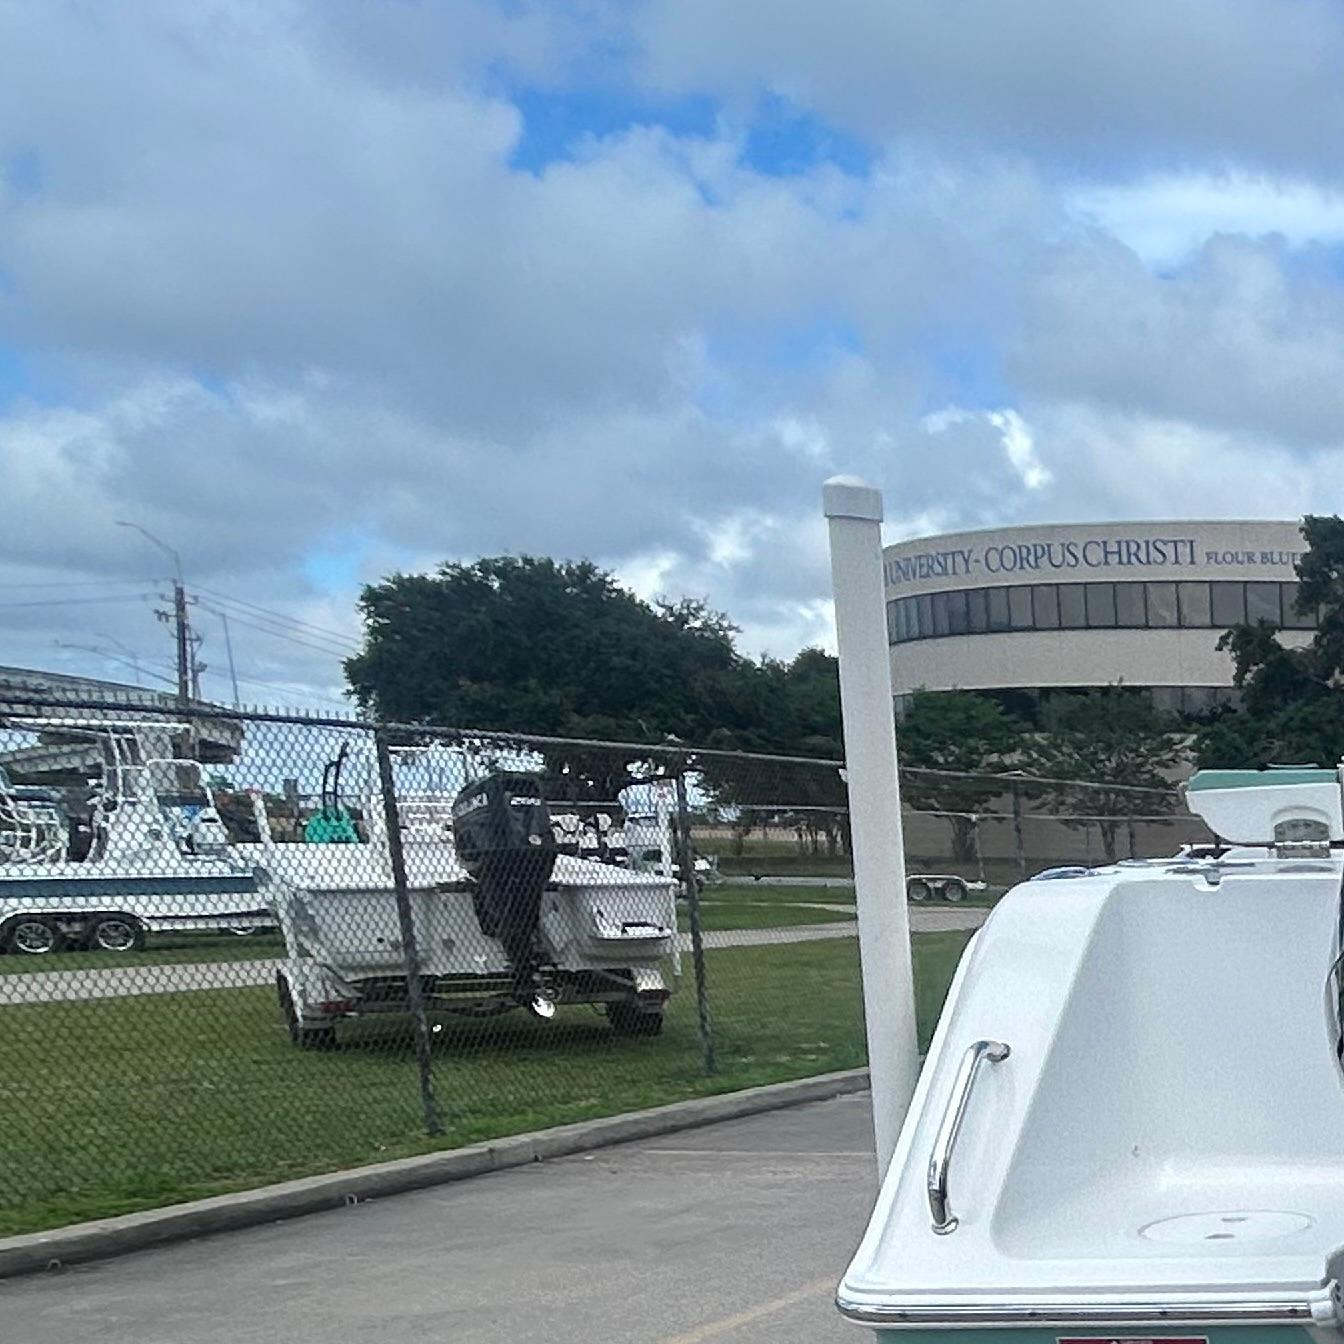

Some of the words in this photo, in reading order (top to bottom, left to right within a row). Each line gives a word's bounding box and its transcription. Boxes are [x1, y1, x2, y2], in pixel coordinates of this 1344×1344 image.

[985, 541, 1079, 574] CORPUS
[1082, 539, 1197, 568] CHRISTI
[1205, 551, 1257, 566] FLOUR
[1260, 551, 1303, 566] BLUF
